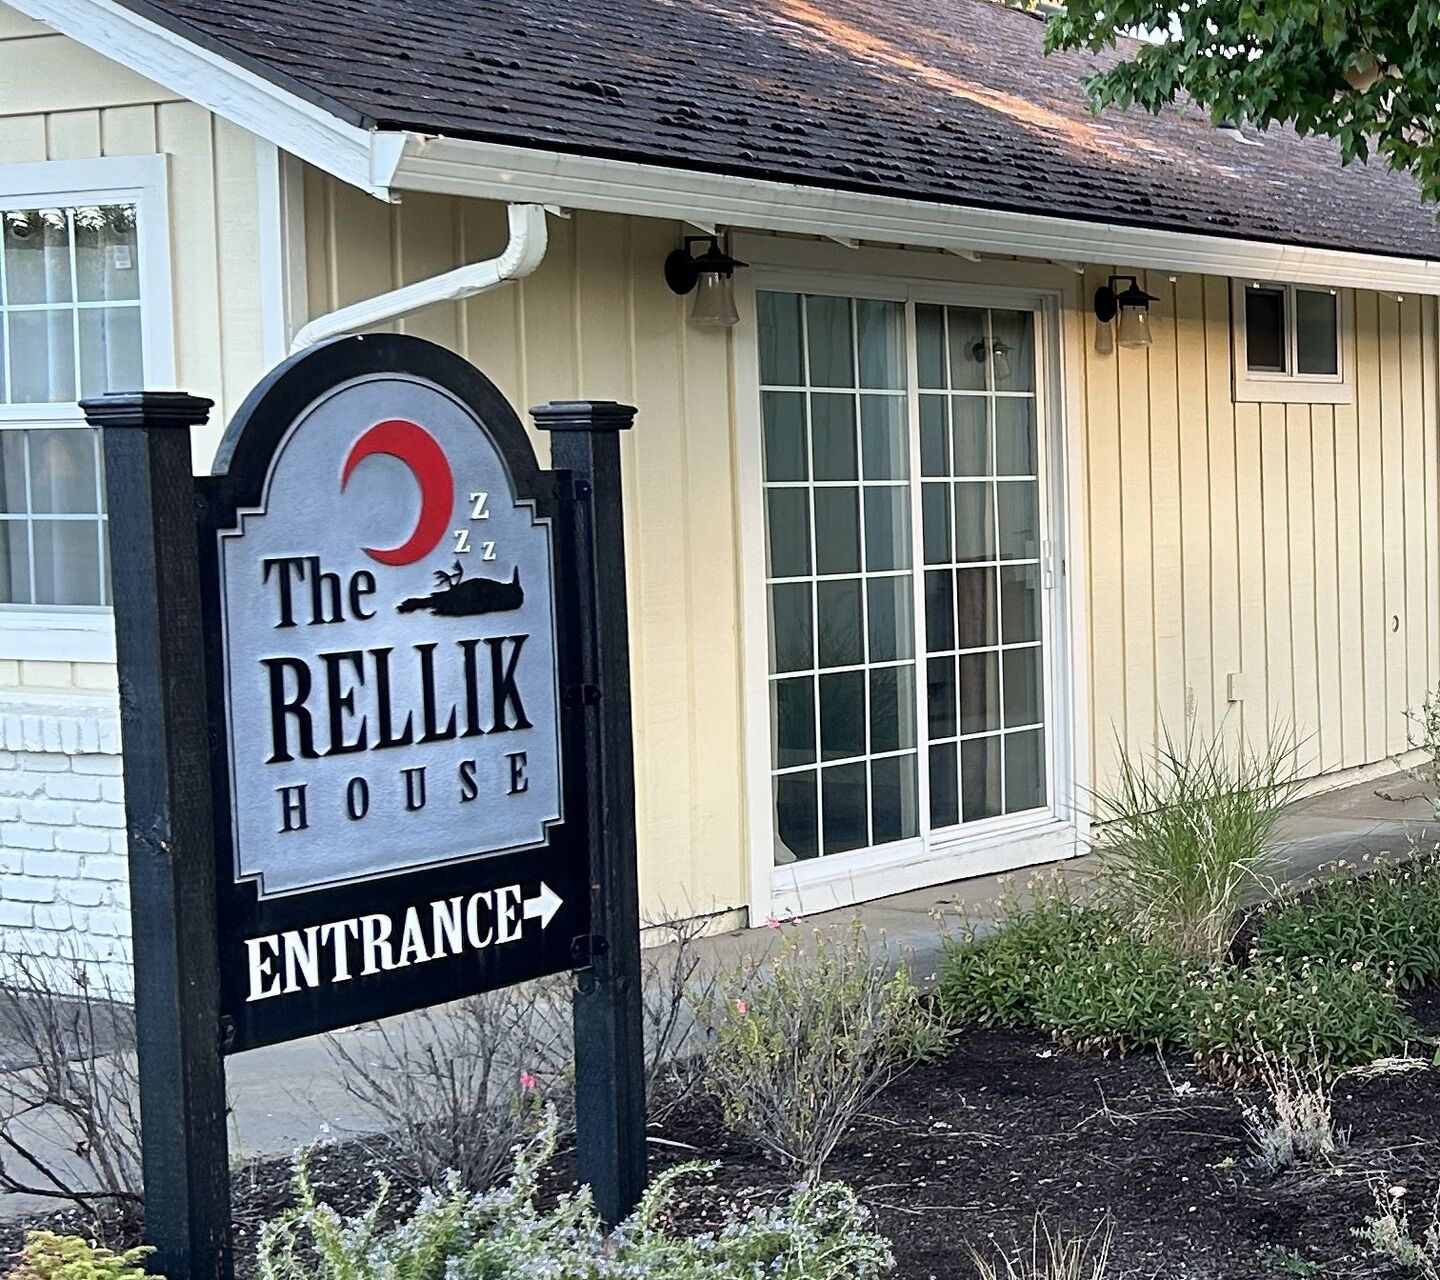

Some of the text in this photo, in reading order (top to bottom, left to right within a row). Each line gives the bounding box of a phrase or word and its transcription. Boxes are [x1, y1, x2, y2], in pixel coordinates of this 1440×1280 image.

[262, 556, 377, 628] The
[259, 634, 533, 764] RELLIK
[275, 752, 529, 833] HOUSE
[244, 884, 523, 1002] ENTRANCE
